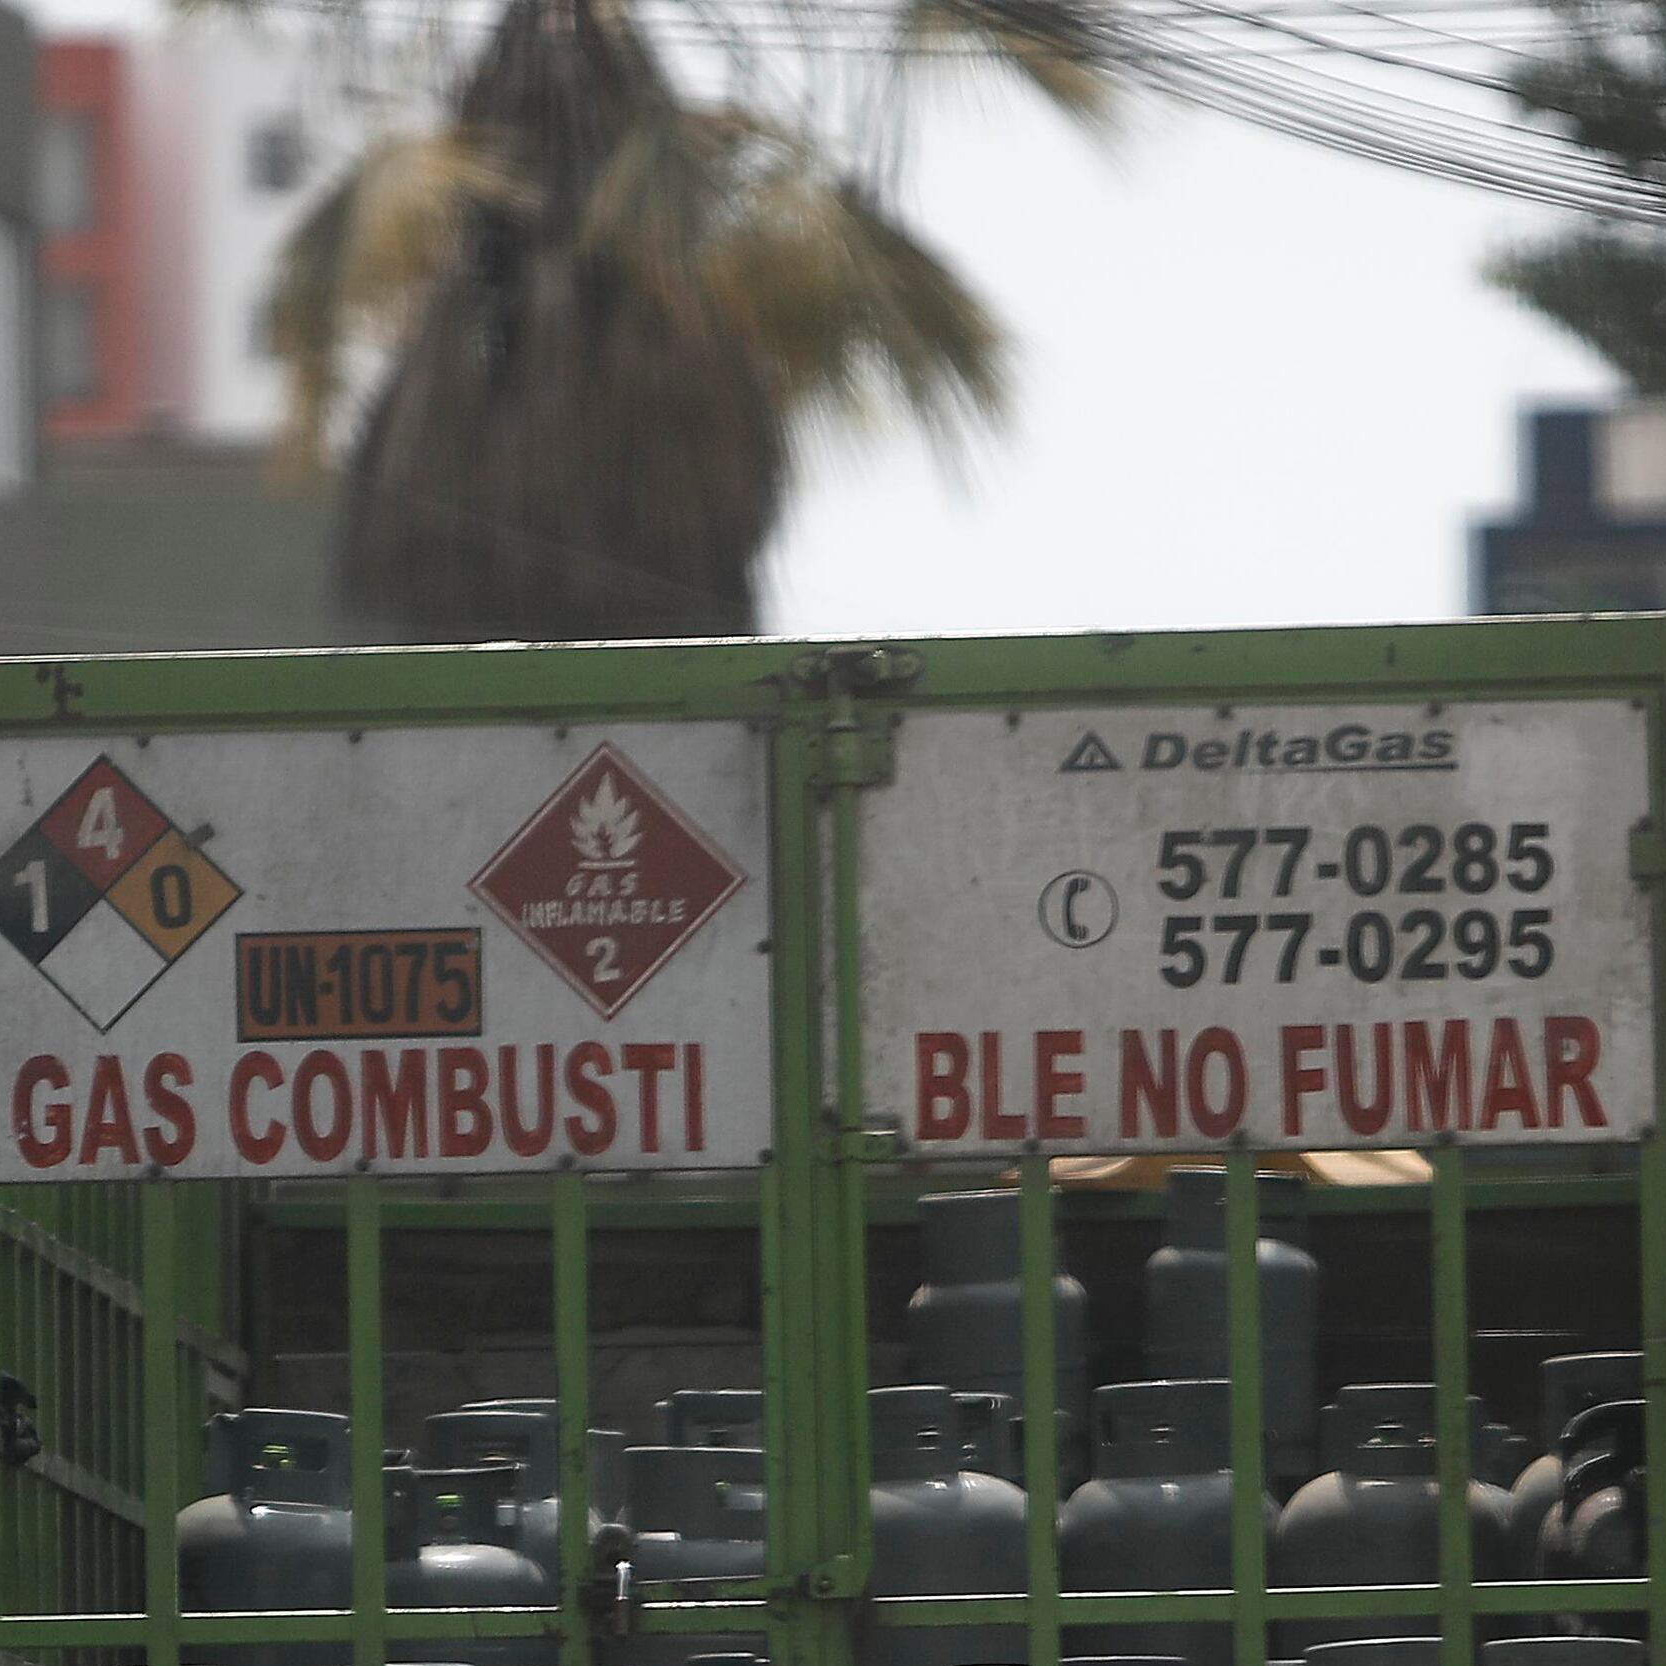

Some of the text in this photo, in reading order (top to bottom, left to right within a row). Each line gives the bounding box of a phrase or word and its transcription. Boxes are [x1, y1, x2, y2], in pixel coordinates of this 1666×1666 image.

[1141, 723, 1454, 770] DeltaGas
[76, 786, 125, 860] 4
[13, 859, 193, 933] 1 0
[564, 873, 639, 897] GAS
[1157, 822, 1555, 901] 577-0285
[247, 942, 475, 1028] UN-1075
[585, 936, 623, 984] 2
[1159, 908, 1555, 989] 577-0295
[10, 1040, 707, 1168] GAS COMBUSTI
[914, 1015, 1609, 1142] BLE NO FUMAR
